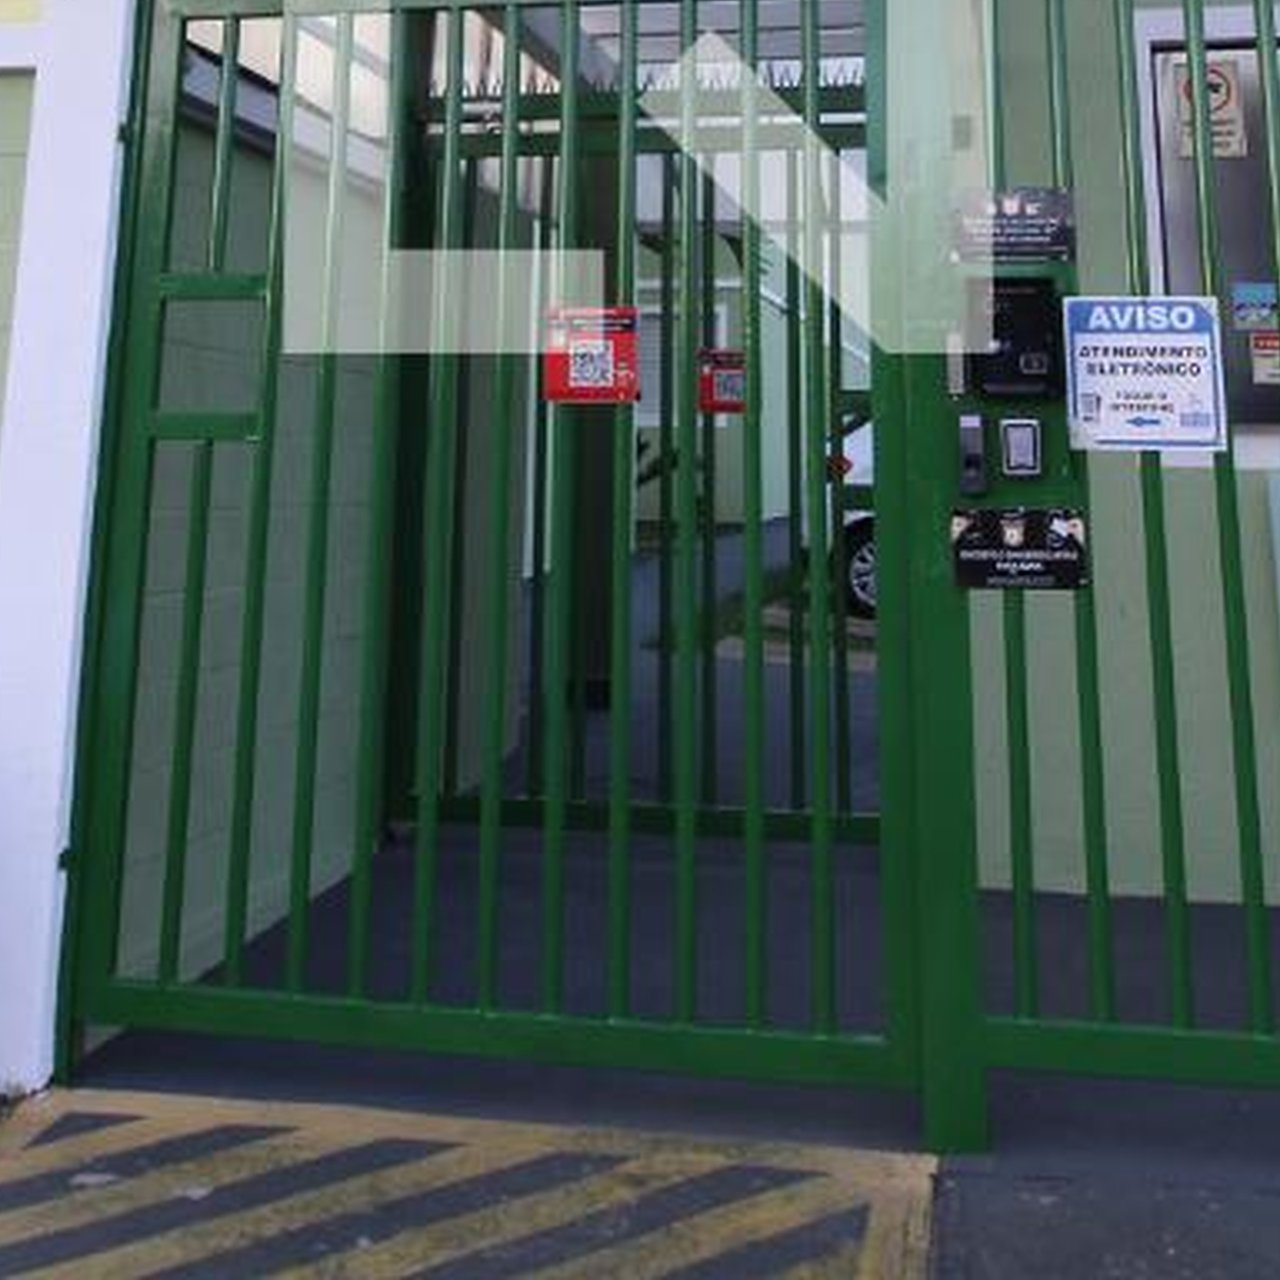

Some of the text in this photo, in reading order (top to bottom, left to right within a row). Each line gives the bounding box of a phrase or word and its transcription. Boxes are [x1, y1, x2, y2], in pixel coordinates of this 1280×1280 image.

[1088, 305, 1195, 330] AVISO
[1079, 346, 1207, 358] ATENDIMENTO
[1086, 361, 1201, 377] ELETRÔNICO
